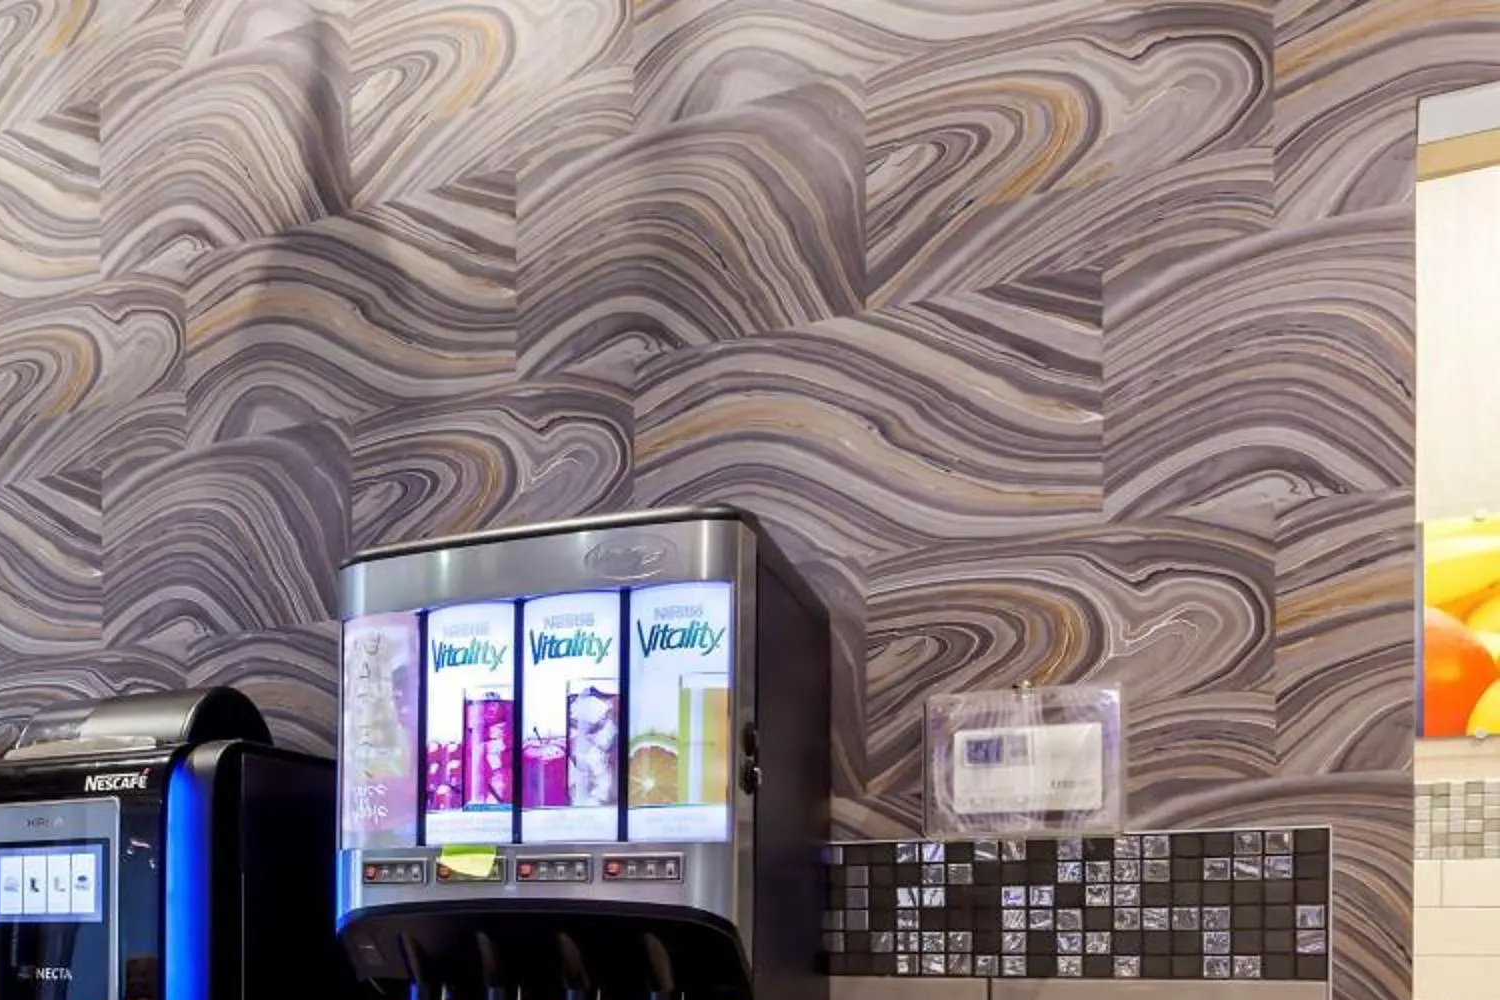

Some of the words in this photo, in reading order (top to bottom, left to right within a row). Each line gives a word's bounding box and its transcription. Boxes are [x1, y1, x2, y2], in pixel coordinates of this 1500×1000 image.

[431, 637, 508, 673] Vitality
[529, 628, 613, 666] Vitality
[636, 619, 726, 659] Vitality
[35, 967, 73, 980] NECTA
